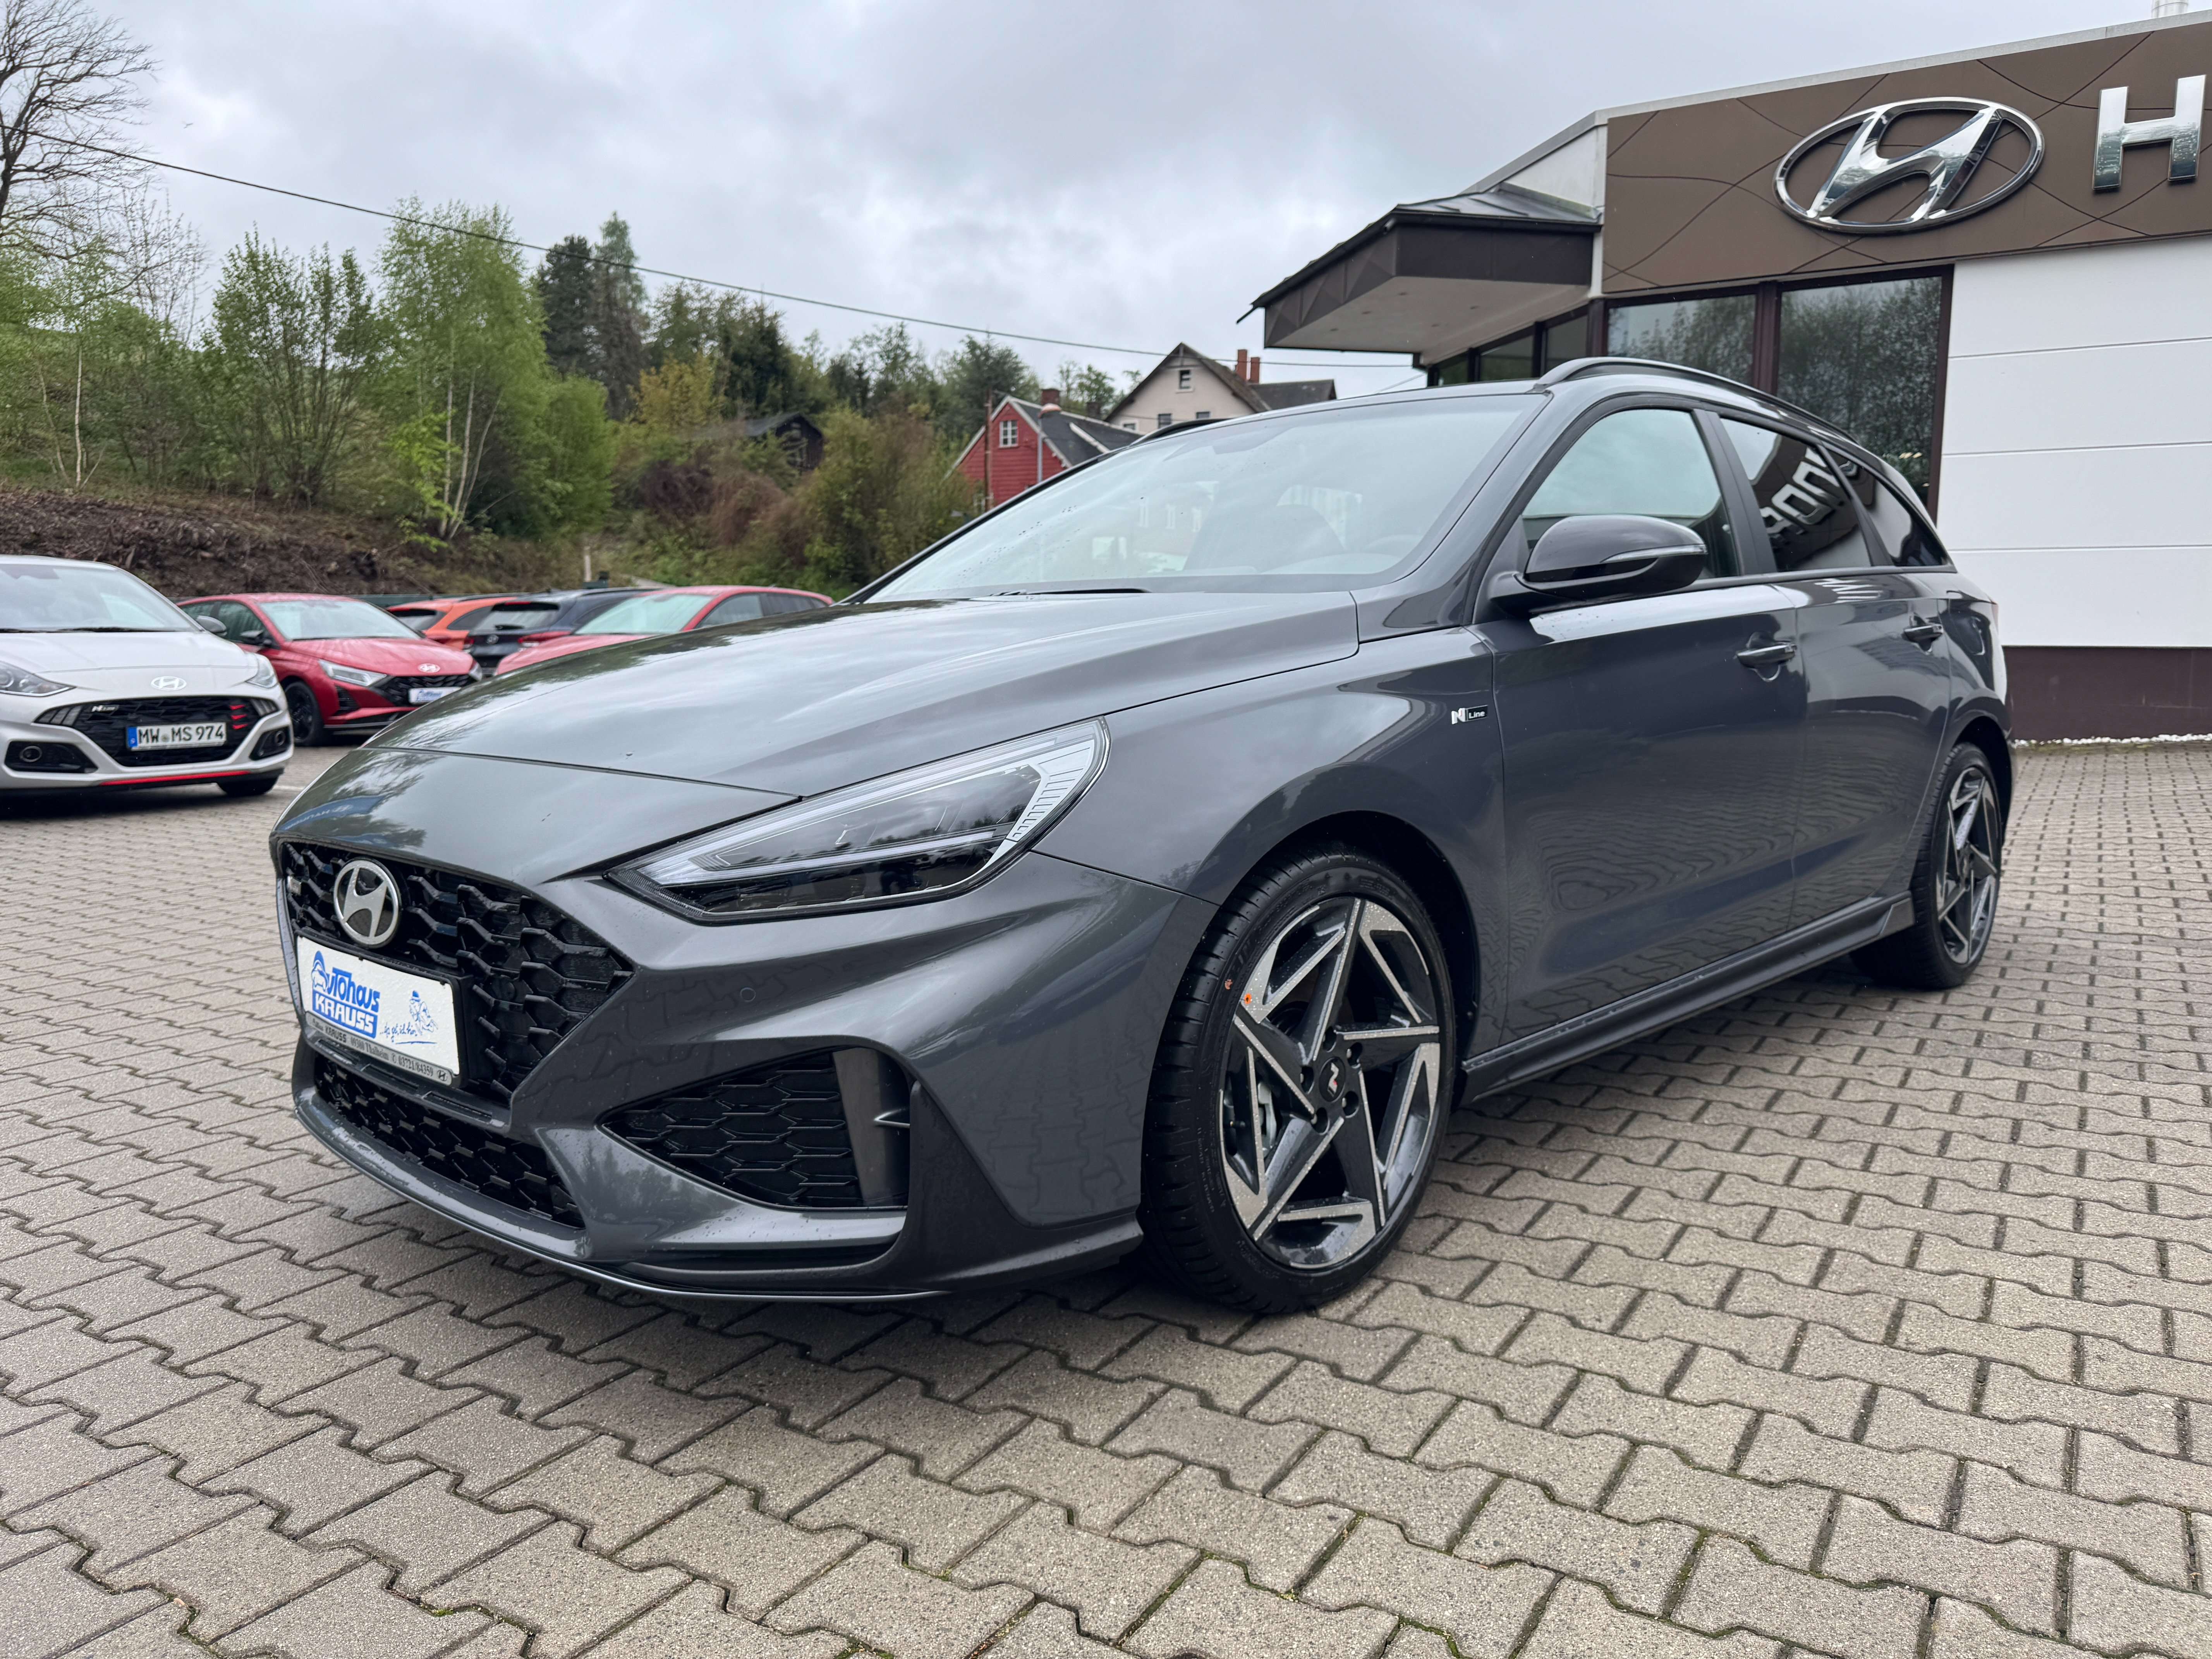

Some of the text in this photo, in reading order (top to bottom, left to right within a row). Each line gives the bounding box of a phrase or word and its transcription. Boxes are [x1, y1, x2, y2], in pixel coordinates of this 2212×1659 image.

[2092, 74, 2206, 191] H
[138, 728, 160, 744] MW
[171, 727, 192, 742] MS
[196, 725, 223, 740] 974
[315, 993, 374, 1034] KRAUSS
[325, 1025, 347, 1042] KRAUSS
